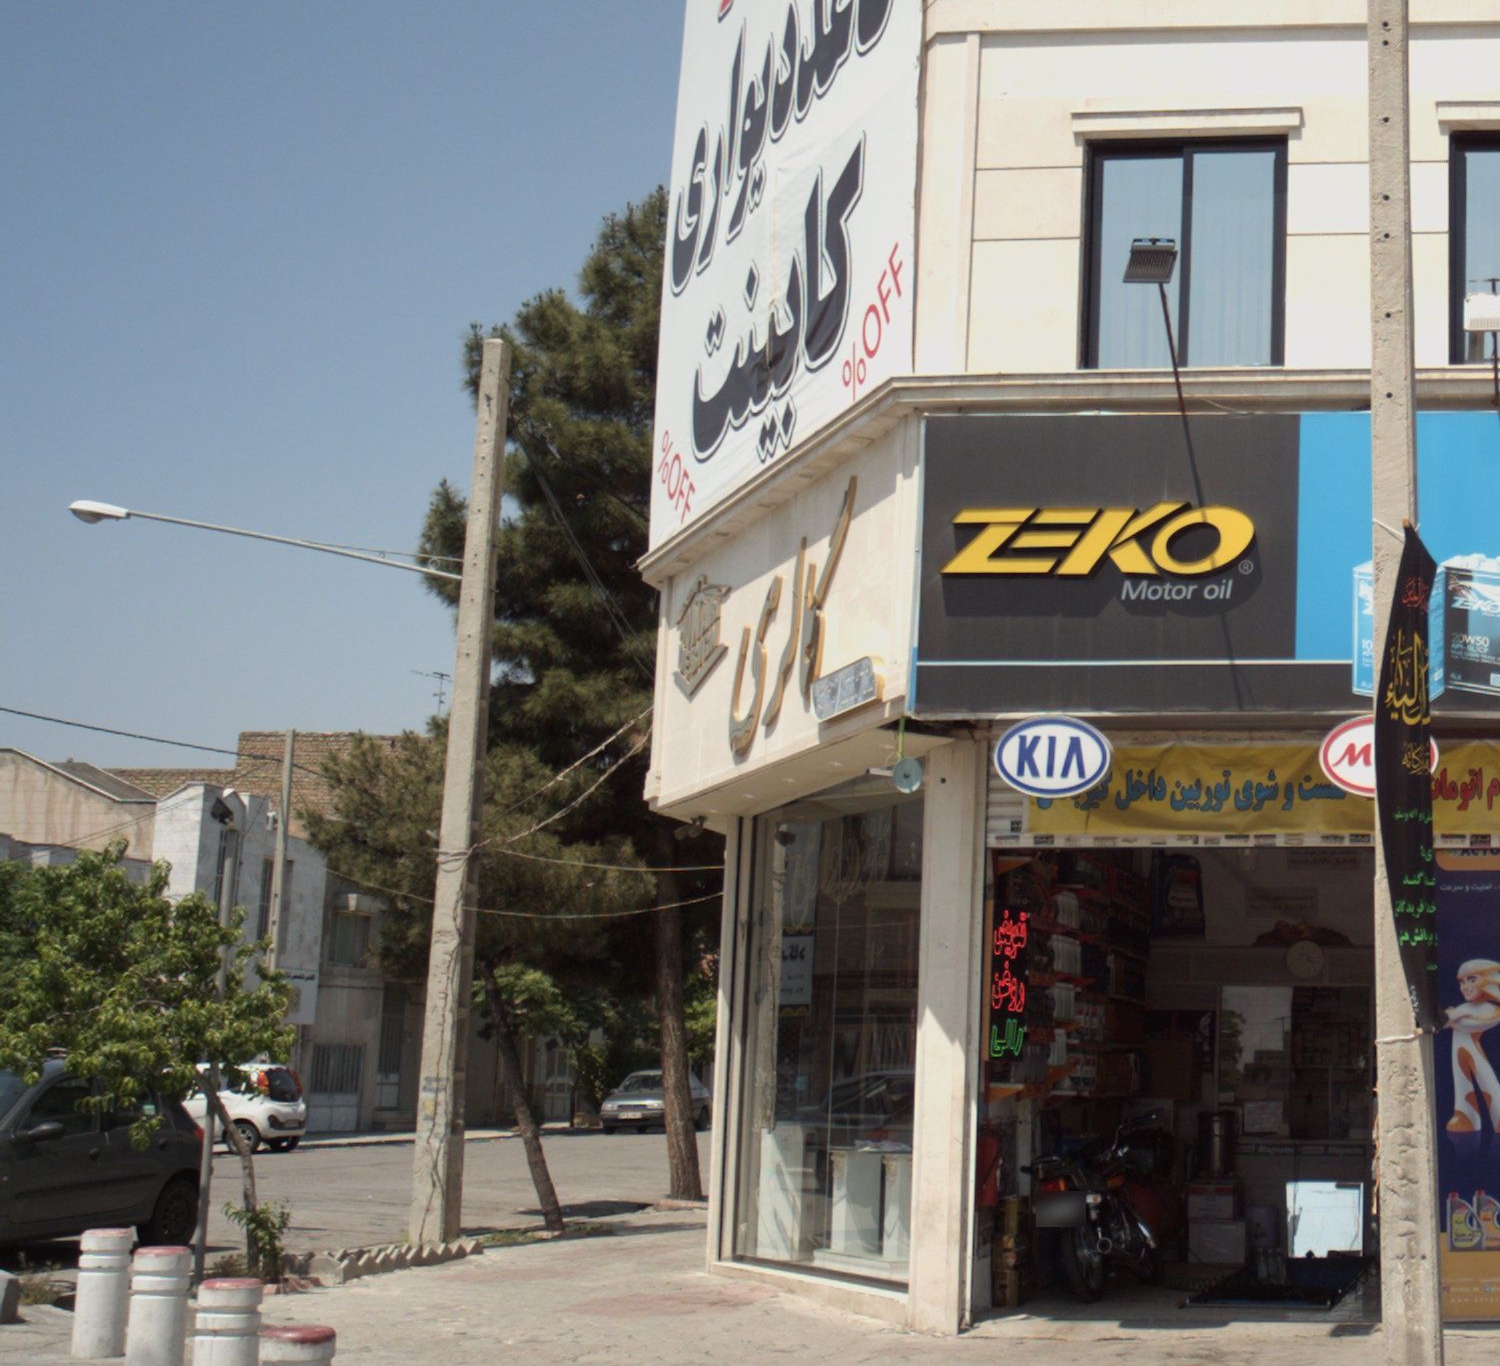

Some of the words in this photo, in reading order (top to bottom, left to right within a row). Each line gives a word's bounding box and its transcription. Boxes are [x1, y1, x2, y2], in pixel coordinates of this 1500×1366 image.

[690, 128, 868, 466] کابینت
[842, 242, 905, 403] %OFF
[660, 427, 697, 525] %OFF
[940, 500, 1256, 577] ZEKO
[1120, 578, 1195, 603] Motor
[1198, 578, 1233, 601] oil
[1015, 734, 1087, 780] KIA
[1114, 768, 1168, 811] داخل
